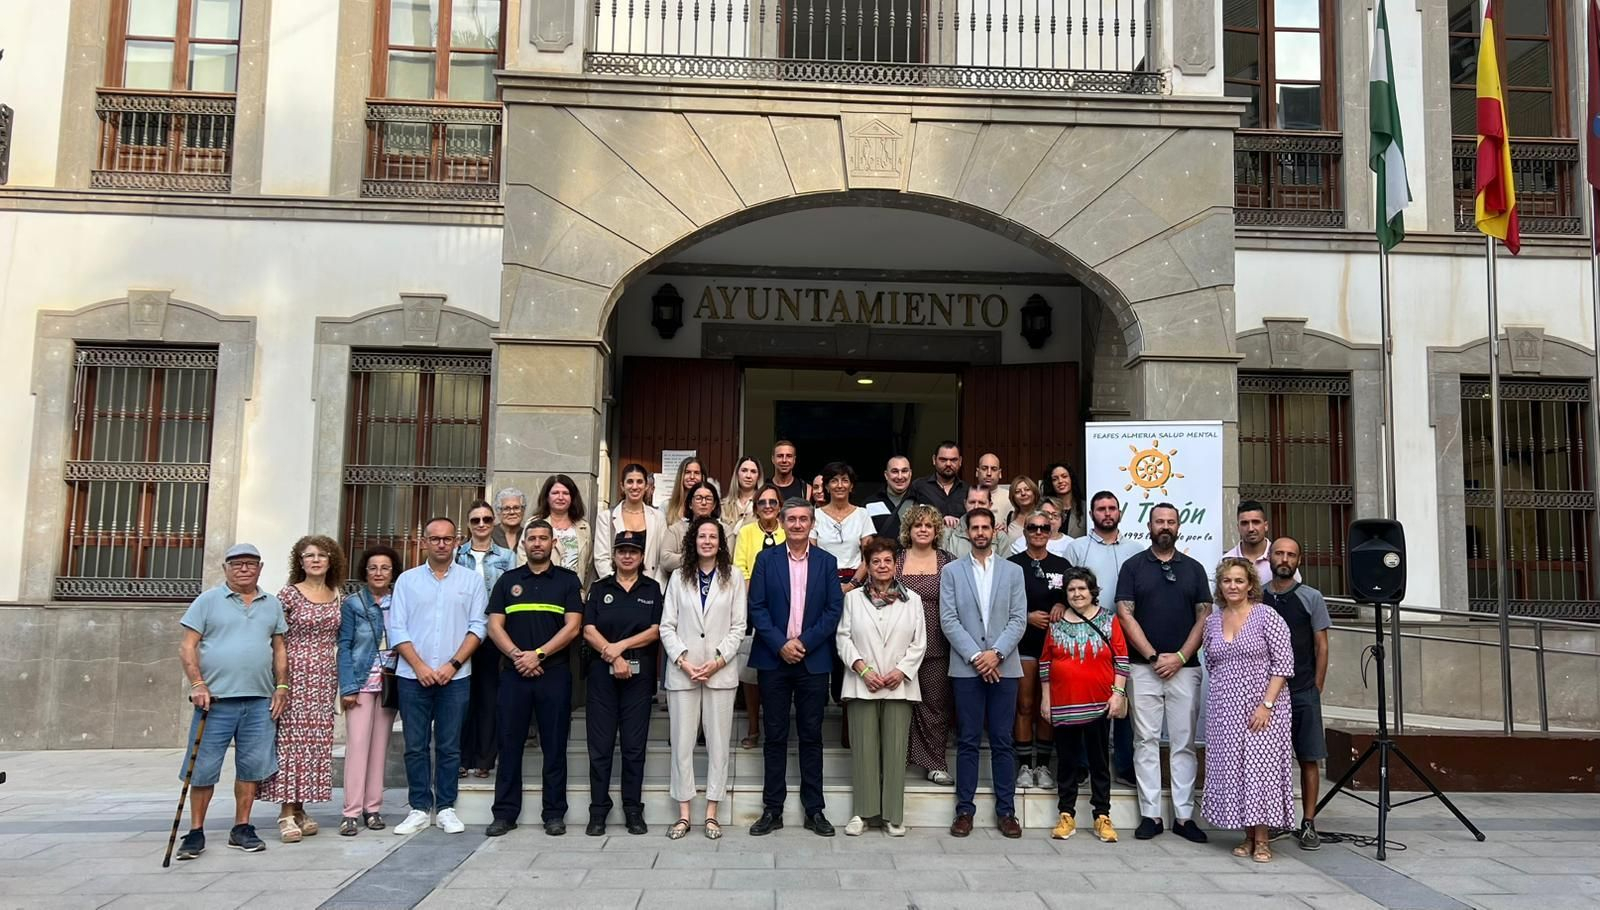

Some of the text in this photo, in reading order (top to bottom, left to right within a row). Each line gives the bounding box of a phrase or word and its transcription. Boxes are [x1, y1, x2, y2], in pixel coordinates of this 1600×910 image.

[693, 285, 1008, 328] AYUNTAMIENTO
[1137, 501, 1206, 524] Tón
[1124, 532, 1144, 540] 1995
[1185, 534, 1202, 542] por
